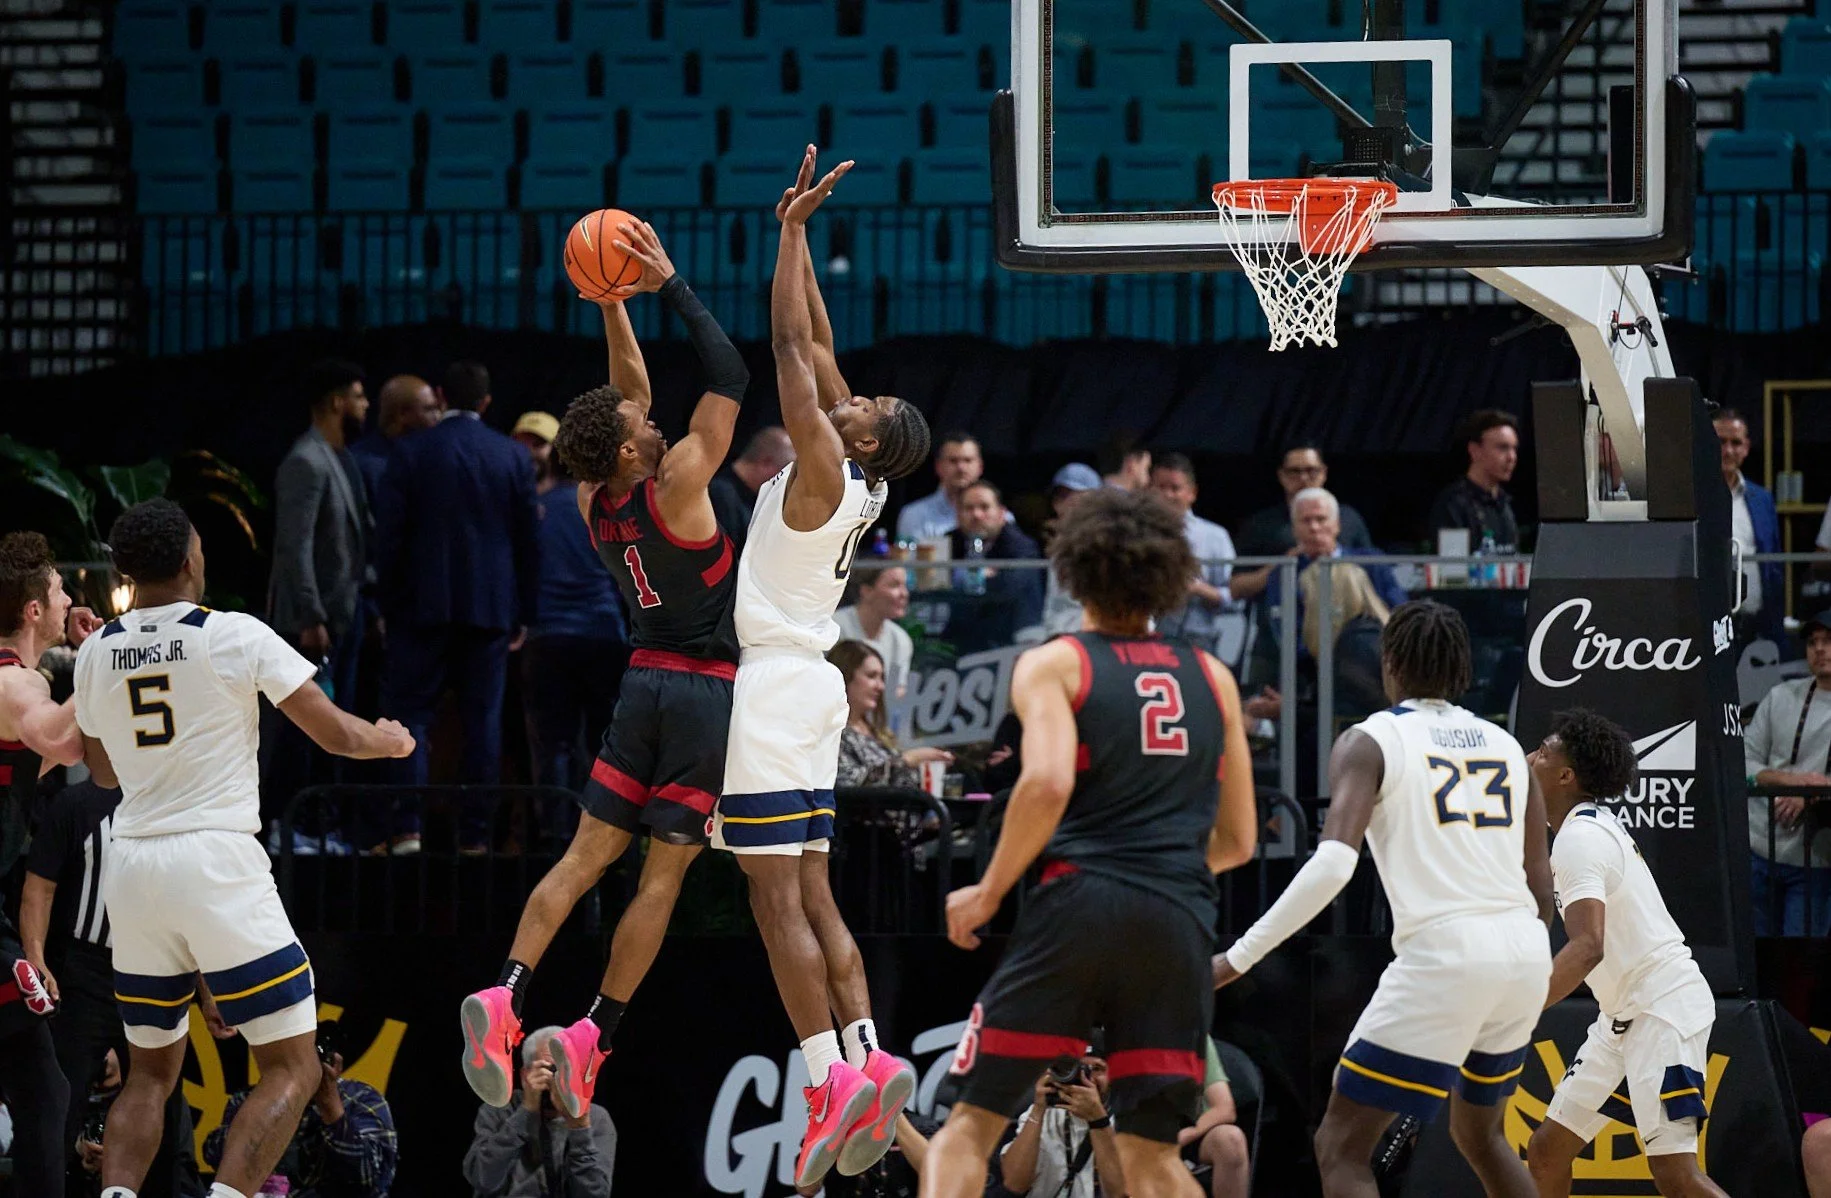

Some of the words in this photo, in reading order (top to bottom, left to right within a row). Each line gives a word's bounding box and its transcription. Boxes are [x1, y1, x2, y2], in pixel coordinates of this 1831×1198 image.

[624, 545, 662, 609] 1
[111, 643, 162, 671] THOMAS
[165, 639, 188, 662] JR.
[1528, 597, 1702, 688] Circa
[125, 673, 176, 749] 5
[1135, 671, 1190, 757] 2
[1723, 702, 1745, 738] JSX
[1424, 752, 1513, 831] 23
